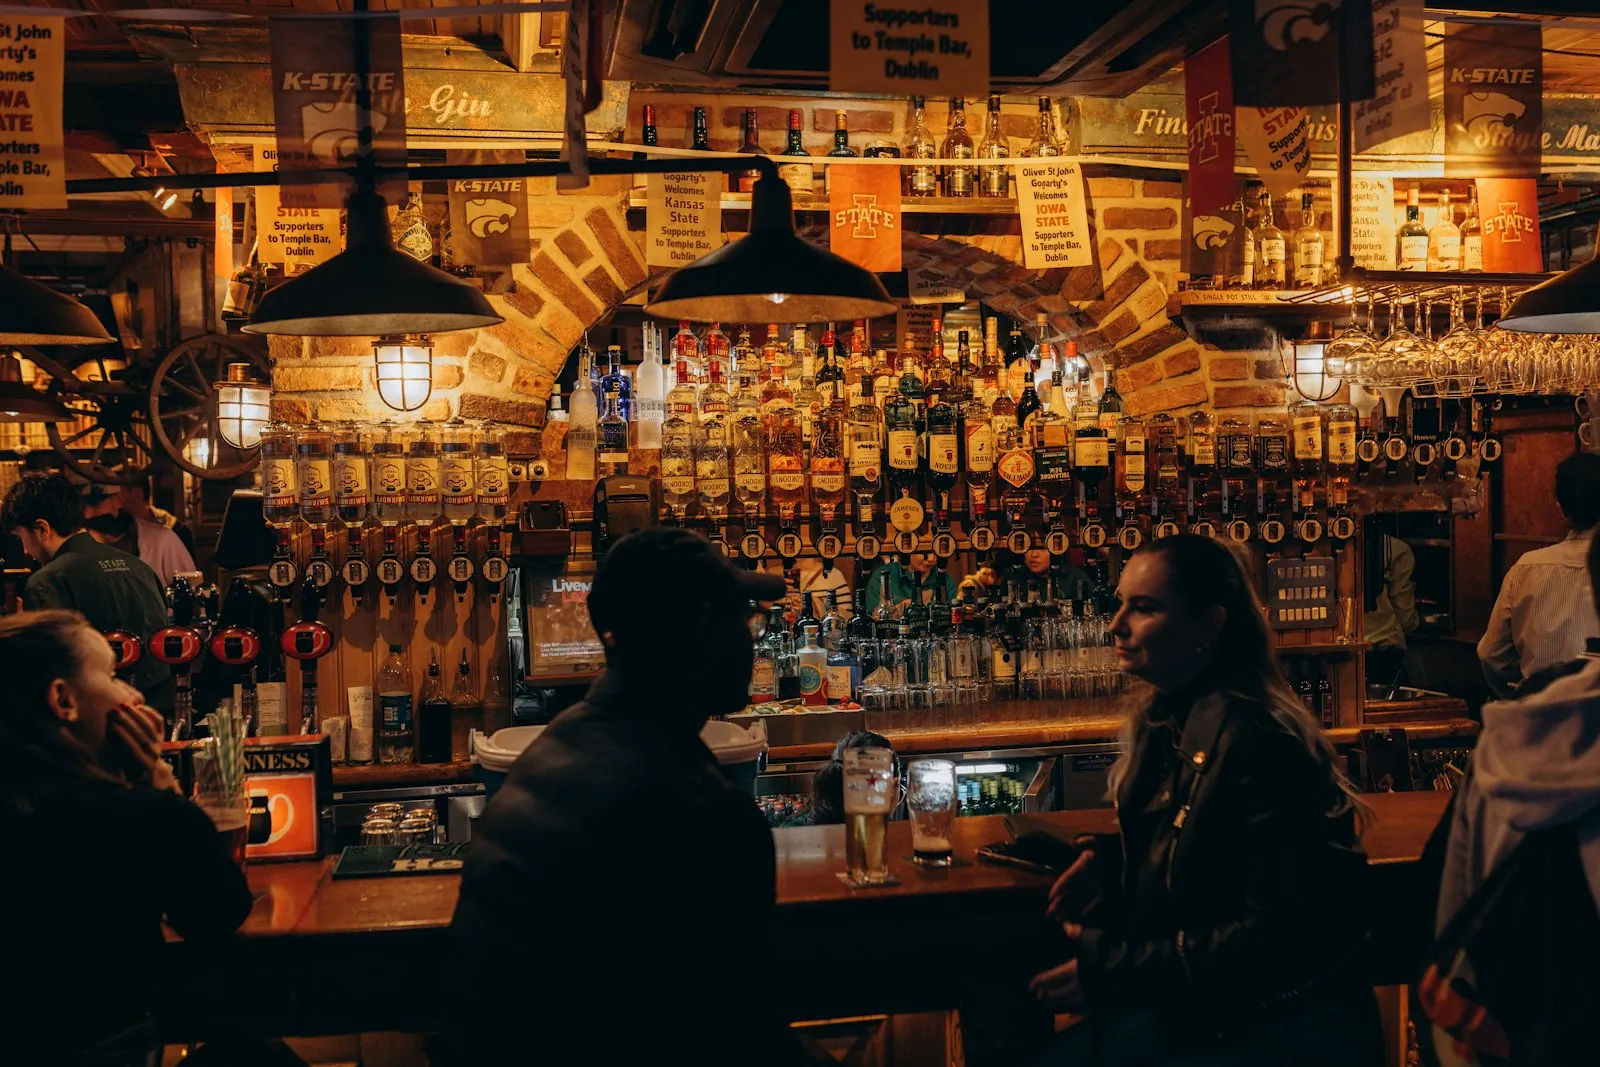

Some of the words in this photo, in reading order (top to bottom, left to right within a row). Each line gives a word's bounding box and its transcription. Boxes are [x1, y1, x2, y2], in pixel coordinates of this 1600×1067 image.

[864, 4, 960, 28] Supporters
[15, 24, 52, 41] John
[852, 32, 870, 49] to
[874, 32, 935, 56] Temple
[939, 35, 972, 58] Bar,
[885, 59, 939, 80] Dublin
[282, 72, 395, 91] K-STATE
[1450, 68, 1536, 84] K-STATE
[424, 84, 492, 124] Gin
[23, 161, 50, 177] Bar,
[1270, 158, 1283, 171] to
[663, 172, 706, 183] Gogarty's
[1022, 168, 1046, 177] Oliver
[1048, 167, 1055, 176] St
[1056, 168, 1075, 177] John
[454, 180, 522, 193] K-STATE
[665, 185, 705, 195] Welcomes
[1031, 180, 1067, 190] Gogarty's
[1033, 191, 1068, 200] Welcomes
[665, 197, 705, 210] Kansas
[1036, 203, 1067, 215] IOWA
[670, 211, 699, 224] State
[836, 208, 894, 229] STATE
[1035, 216, 1069, 227] STATE
[1352, 217, 1380, 225] ansas
[274, 222, 324, 236] Supporters
[1484, 213, 1534, 235] STATE
[661, 226, 706, 237] Supporters
[1034, 230, 1075, 240] Supporters
[1353, 228, 1375, 238] State
[268, 234, 278, 243] to
[280, 235, 311, 246] Temple
[313, 235, 331, 244] Bar,
[656, 238, 664, 247] to
[666, 239, 694, 249] Temple
[695, 240, 712, 250] Bar,
[286, 247, 314, 256] Dublin
[1031, 243, 1038, 251] to
[1040, 242, 1065, 252] Temple
[1066, 241, 1082, 250] Bar,
[670, 251, 696, 261] Dublin
[1045, 253, 1068, 262] Dublin
[1374, 253, 1387, 262] Bar,
[1003, 470, 1030, 481] POWERS
[1040, 472, 1070, 480] TULLAMORE
[97, 559, 126, 569] STAFF
